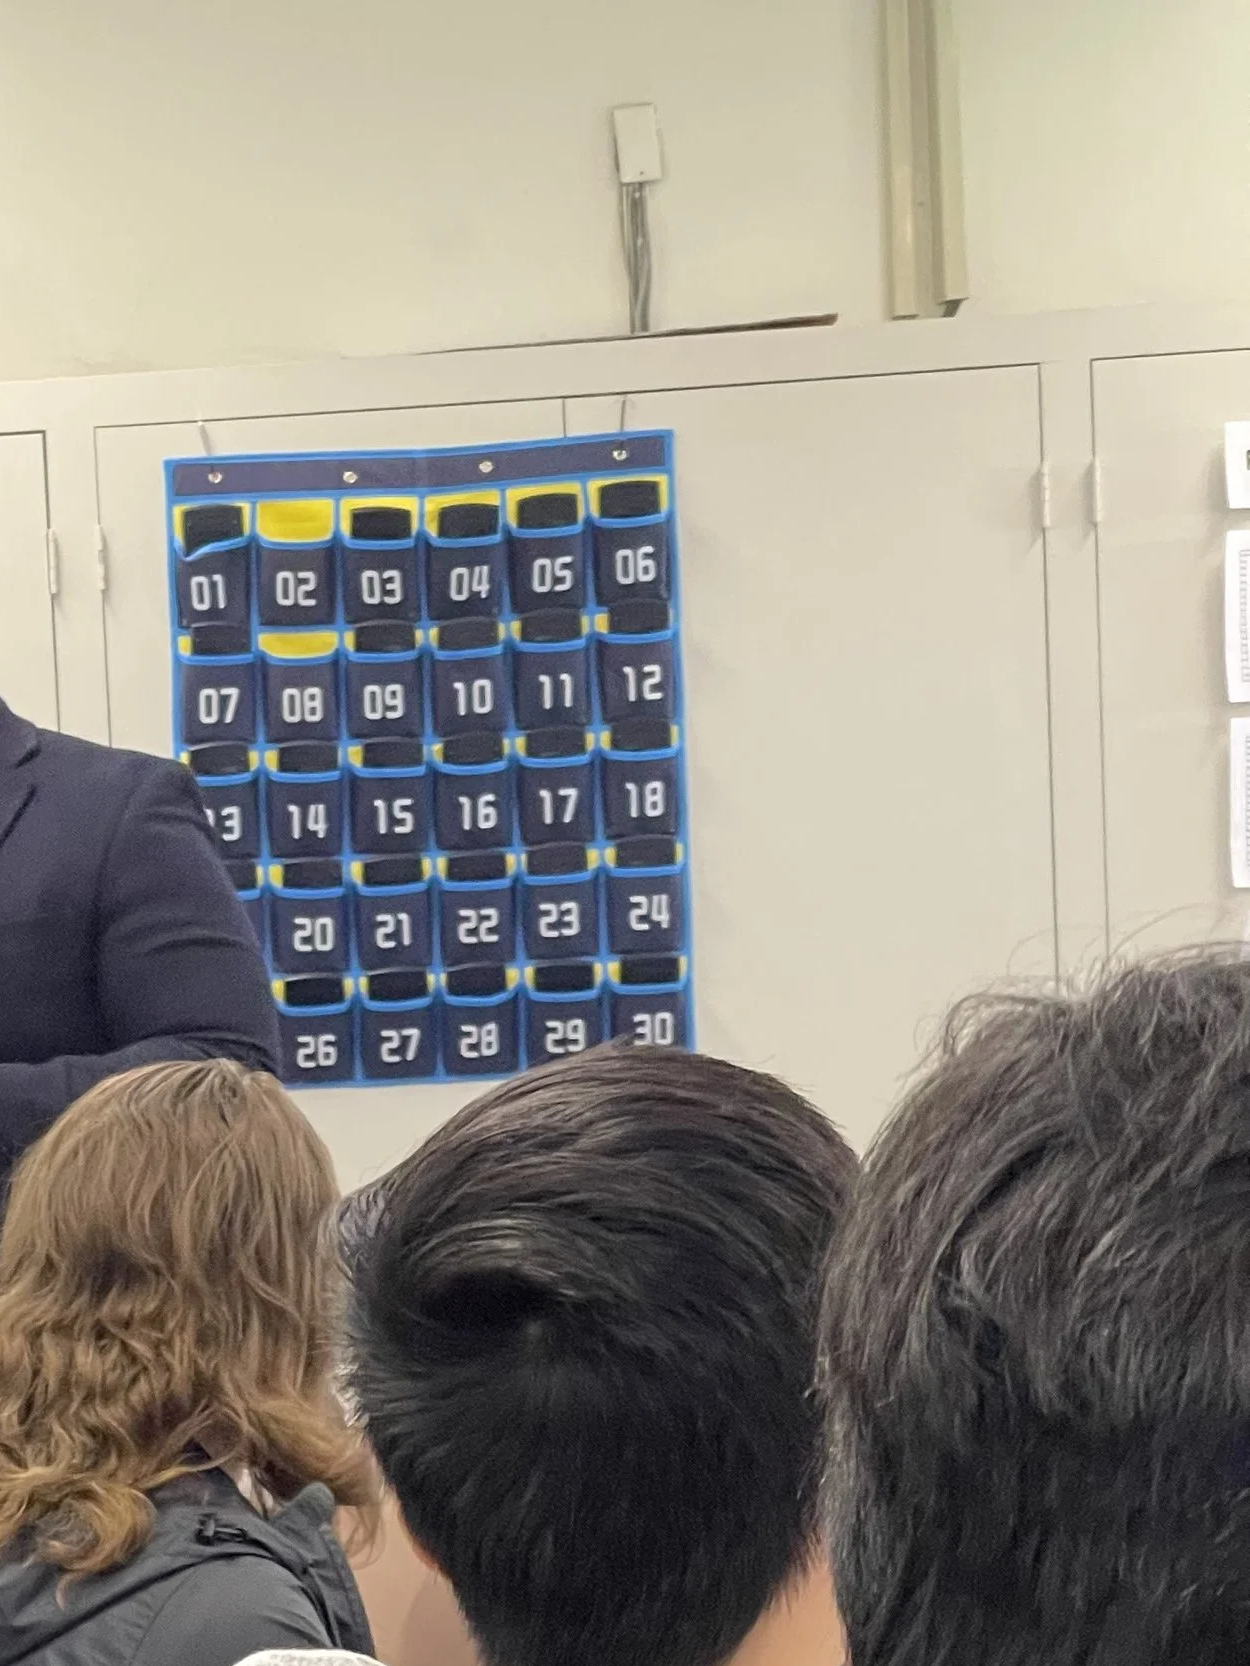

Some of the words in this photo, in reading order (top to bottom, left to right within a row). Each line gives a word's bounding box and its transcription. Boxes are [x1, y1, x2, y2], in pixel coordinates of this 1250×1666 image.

[190, 574, 227, 611] 01
[276, 571, 317, 606] 02
[361, 570, 402, 604] 03
[450, 565, 490, 600] 04
[532, 556, 574, 592] 05
[616, 546, 656, 584] 06
[199, 687, 240, 724] 07
[282, 687, 323, 722] 08
[363, 684, 404, 719] 09
[453, 679, 493, 715] 10
[539, 673, 573, 709] 11
[623, 664, 664, 701] 12
[287, 804, 327, 839] 14
[374, 798, 414, 834] 15
[459, 793, 497, 830] 16
[539, 788, 578, 824] 17
[625, 781, 664, 817] 18
[293, 917, 335, 951] 20
[376, 913, 411, 948] 21
[458, 908, 499, 943] 22
[539, 901, 580, 937] 23
[629, 894, 670, 930] 24
[297, 1034, 337, 1067] 26
[380, 1028, 420, 1062] 27
[459, 1022, 499, 1058] 28
[545, 1018, 586, 1054] 29
[632, 1011, 674, 1046] 30
